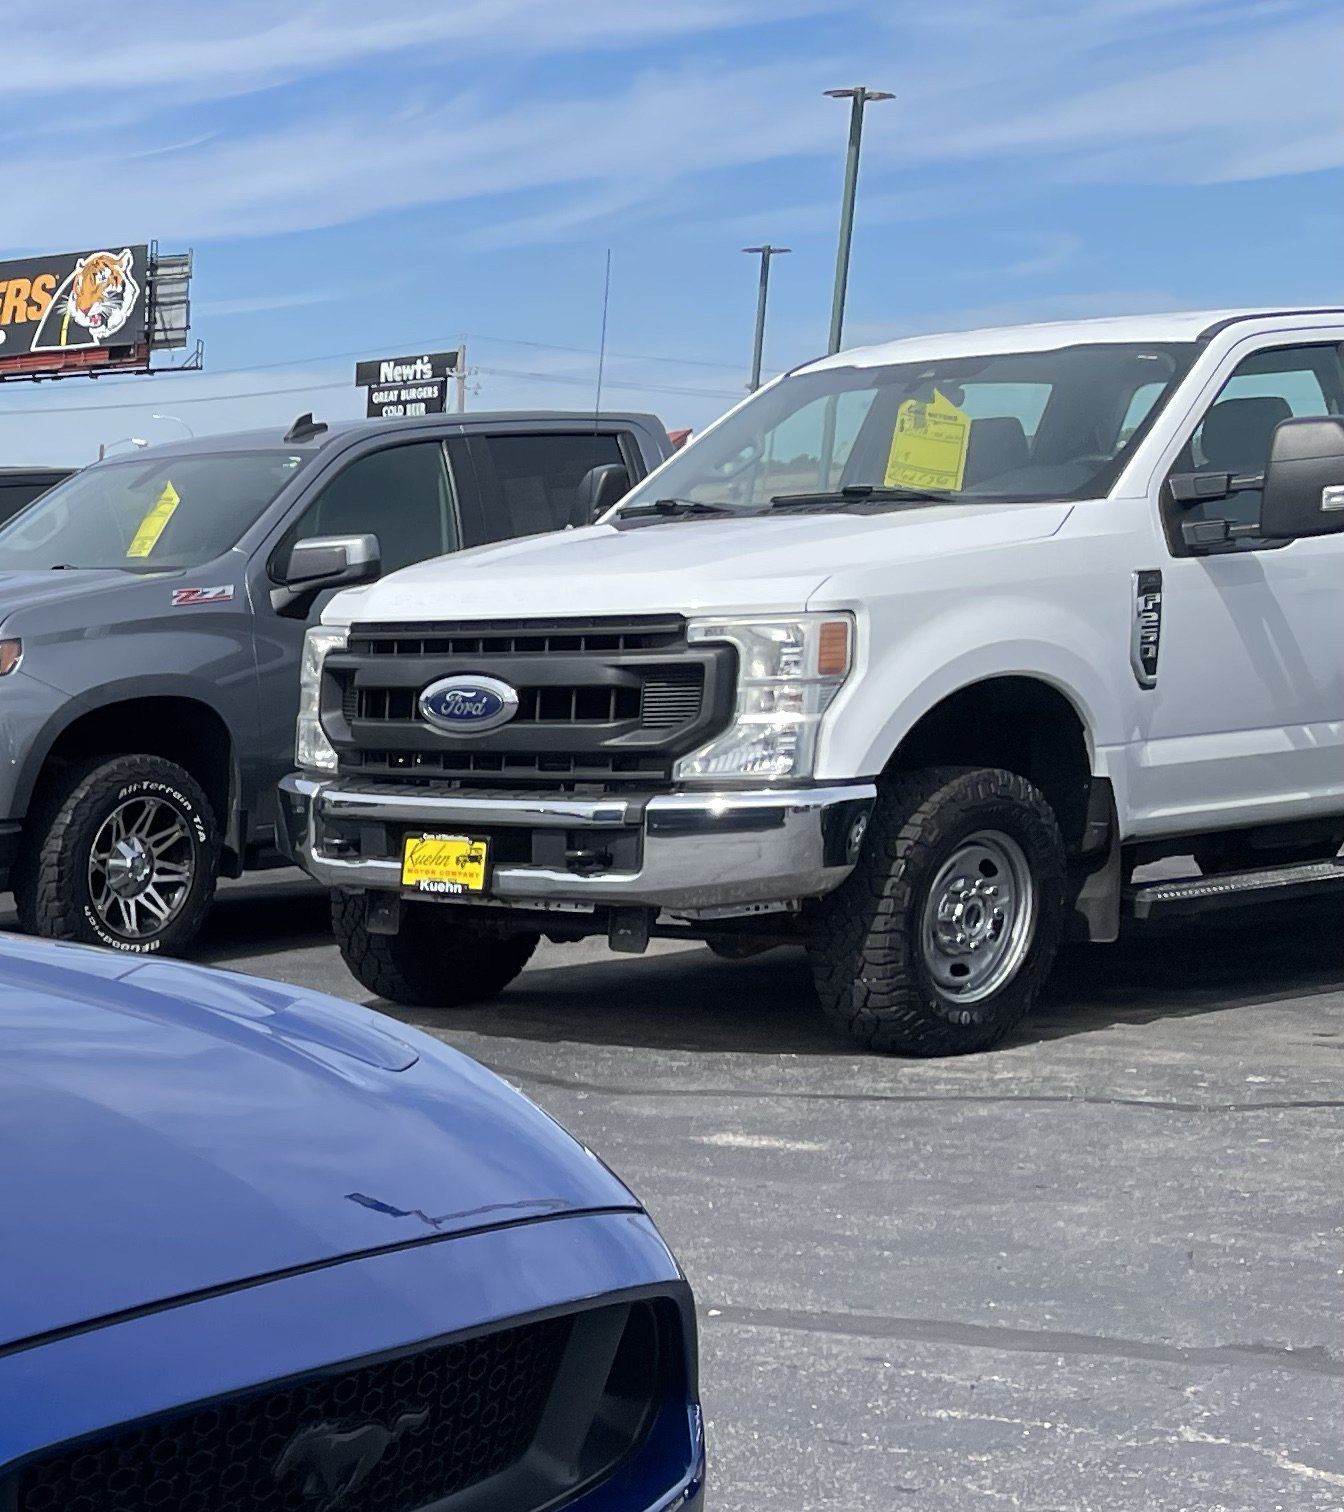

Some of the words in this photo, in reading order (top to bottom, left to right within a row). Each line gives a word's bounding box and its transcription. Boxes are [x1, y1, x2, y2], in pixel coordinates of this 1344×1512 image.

[379, 355, 433, 384] Newt's
[372, 390, 399, 404] GREAT
[400, 385, 439, 402] BURGERS
[381, 404, 405, 417] COLD
[405, 402, 427, 417] BEER
[440, 690, 488, 716] Ford
[406, 842, 452, 868] Kuehn
[407, 867, 436, 875] MOTOR
[439, 869, 480, 878] COMPANY
[419, 879, 463, 894] Kuehn
